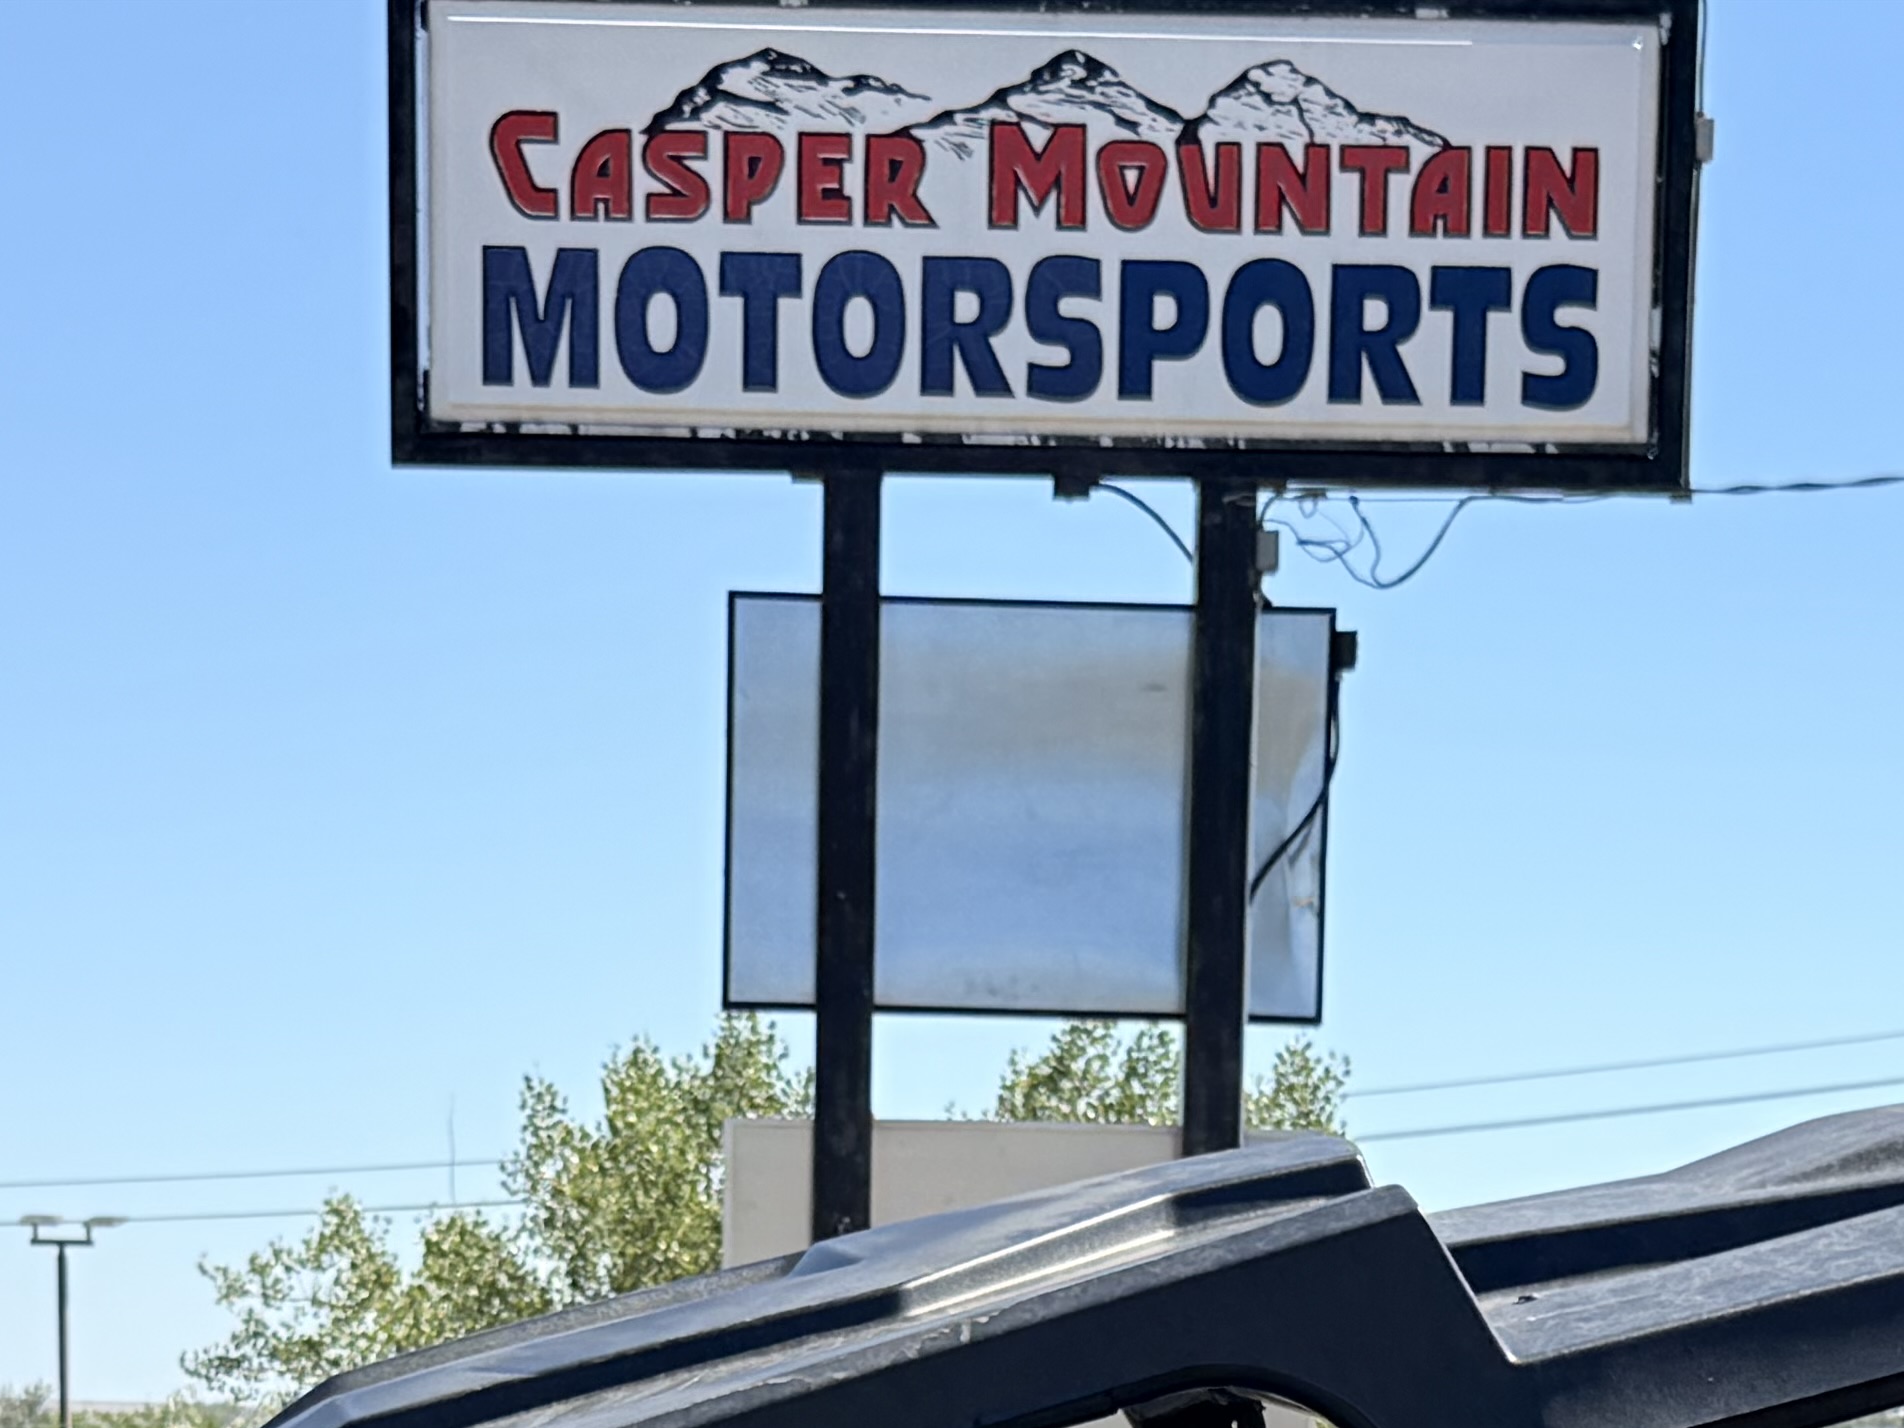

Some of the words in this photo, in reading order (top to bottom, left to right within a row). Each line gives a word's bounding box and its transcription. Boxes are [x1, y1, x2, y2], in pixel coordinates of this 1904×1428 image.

[489, 109, 940, 230] CASPER
[987, 120, 1600, 240] MOUNTAIN
[481, 244, 1600, 408] MOTORSPORTS
